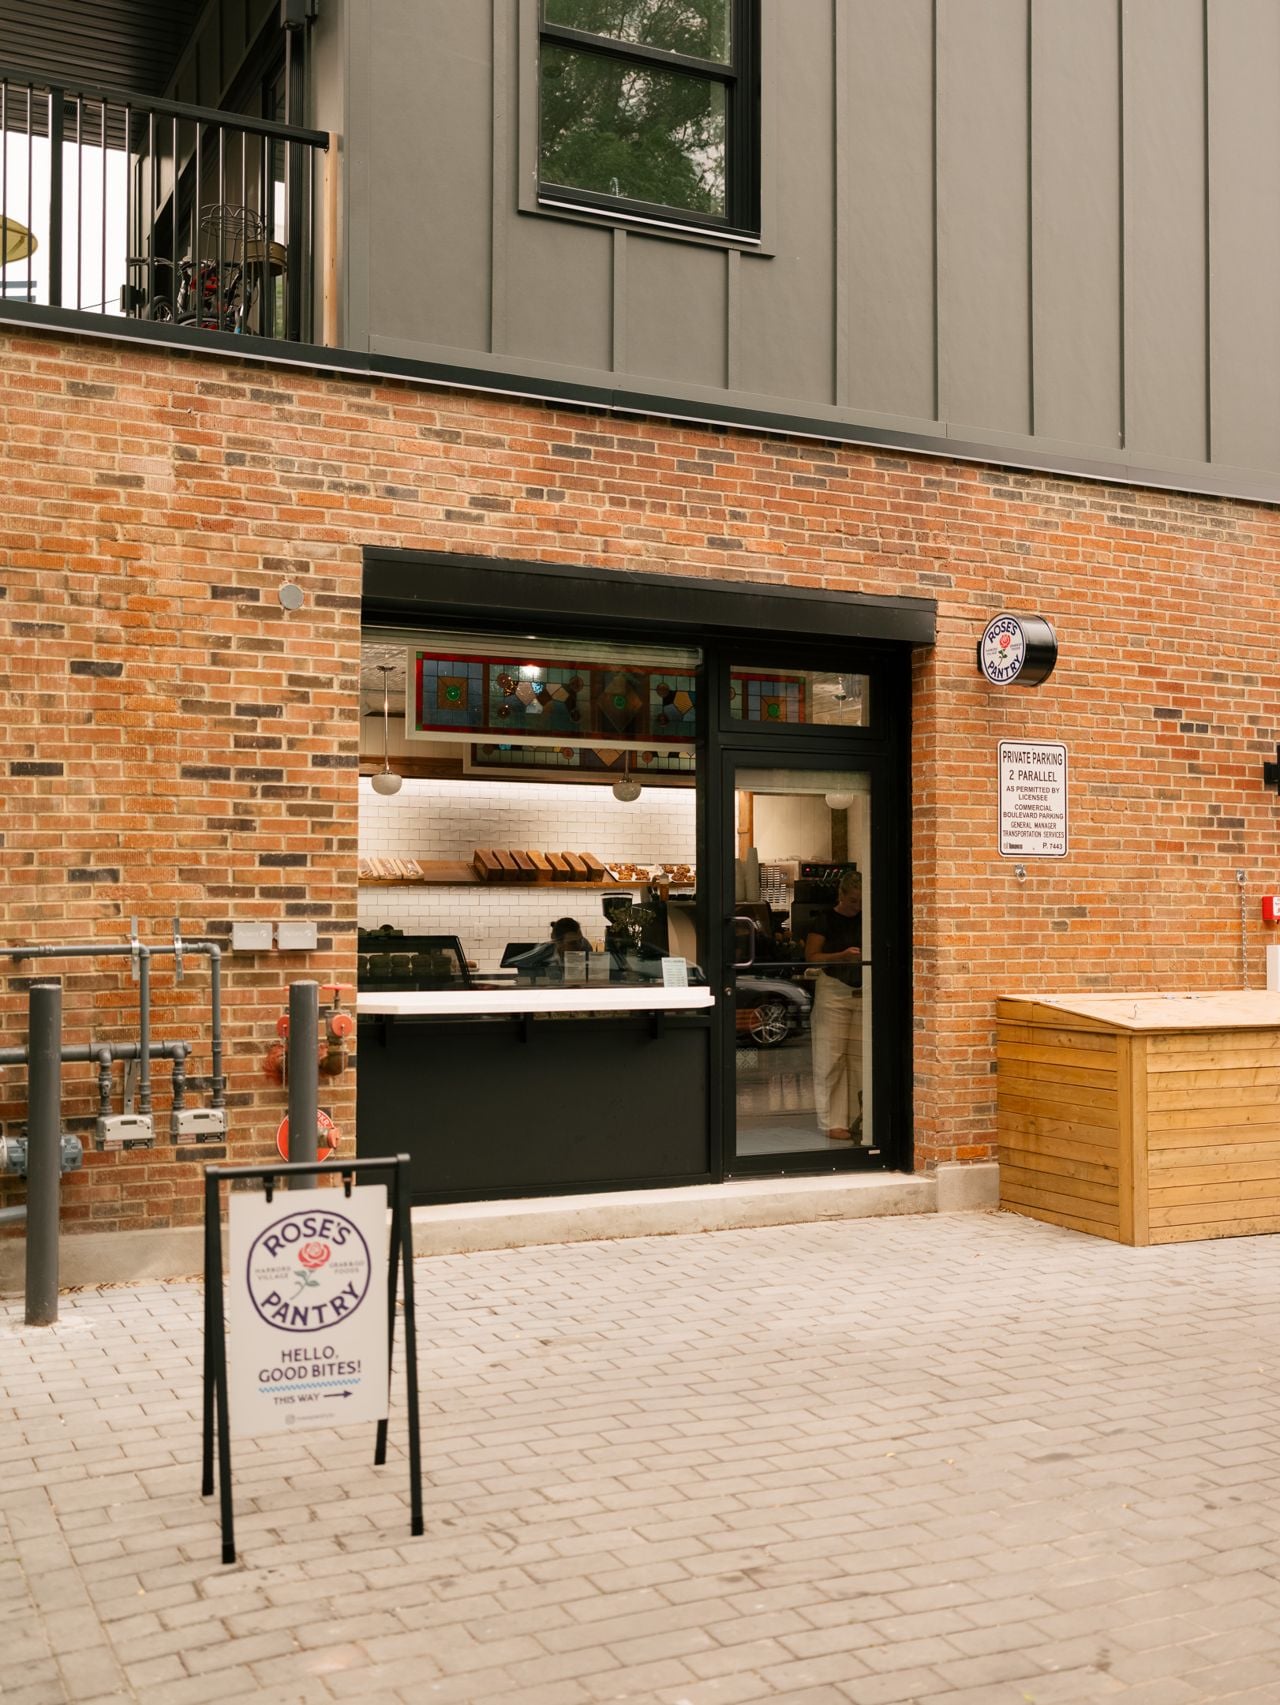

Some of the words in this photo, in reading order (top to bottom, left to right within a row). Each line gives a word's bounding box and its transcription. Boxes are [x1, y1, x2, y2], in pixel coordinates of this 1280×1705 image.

[988, 621, 1017, 643] ROSE'S
[987, 654, 1021, 679] PANTRY
[1002, 750, 1031, 764] PRIVATE
[1032, 751, 1063, 766] PARKING
[1009, 769, 1015, 780] 2
[1018, 770, 1057, 782] PARALLEL
[1003, 830, 1041, 838] TRANSPORTATION
[1043, 831, 1064, 839] SERVICES
[1010, 821, 1032, 829] GENERAL
[262, 1217, 351, 1258] ROSE'S
[261, 1281, 359, 1326] PANTRY
[258, 1366, 308, 1383] GOOD
[311, 1359, 361, 1378] BITES!
[273, 1396, 295, 1405] THIS
[297, 1393, 320, 1402] WAY
